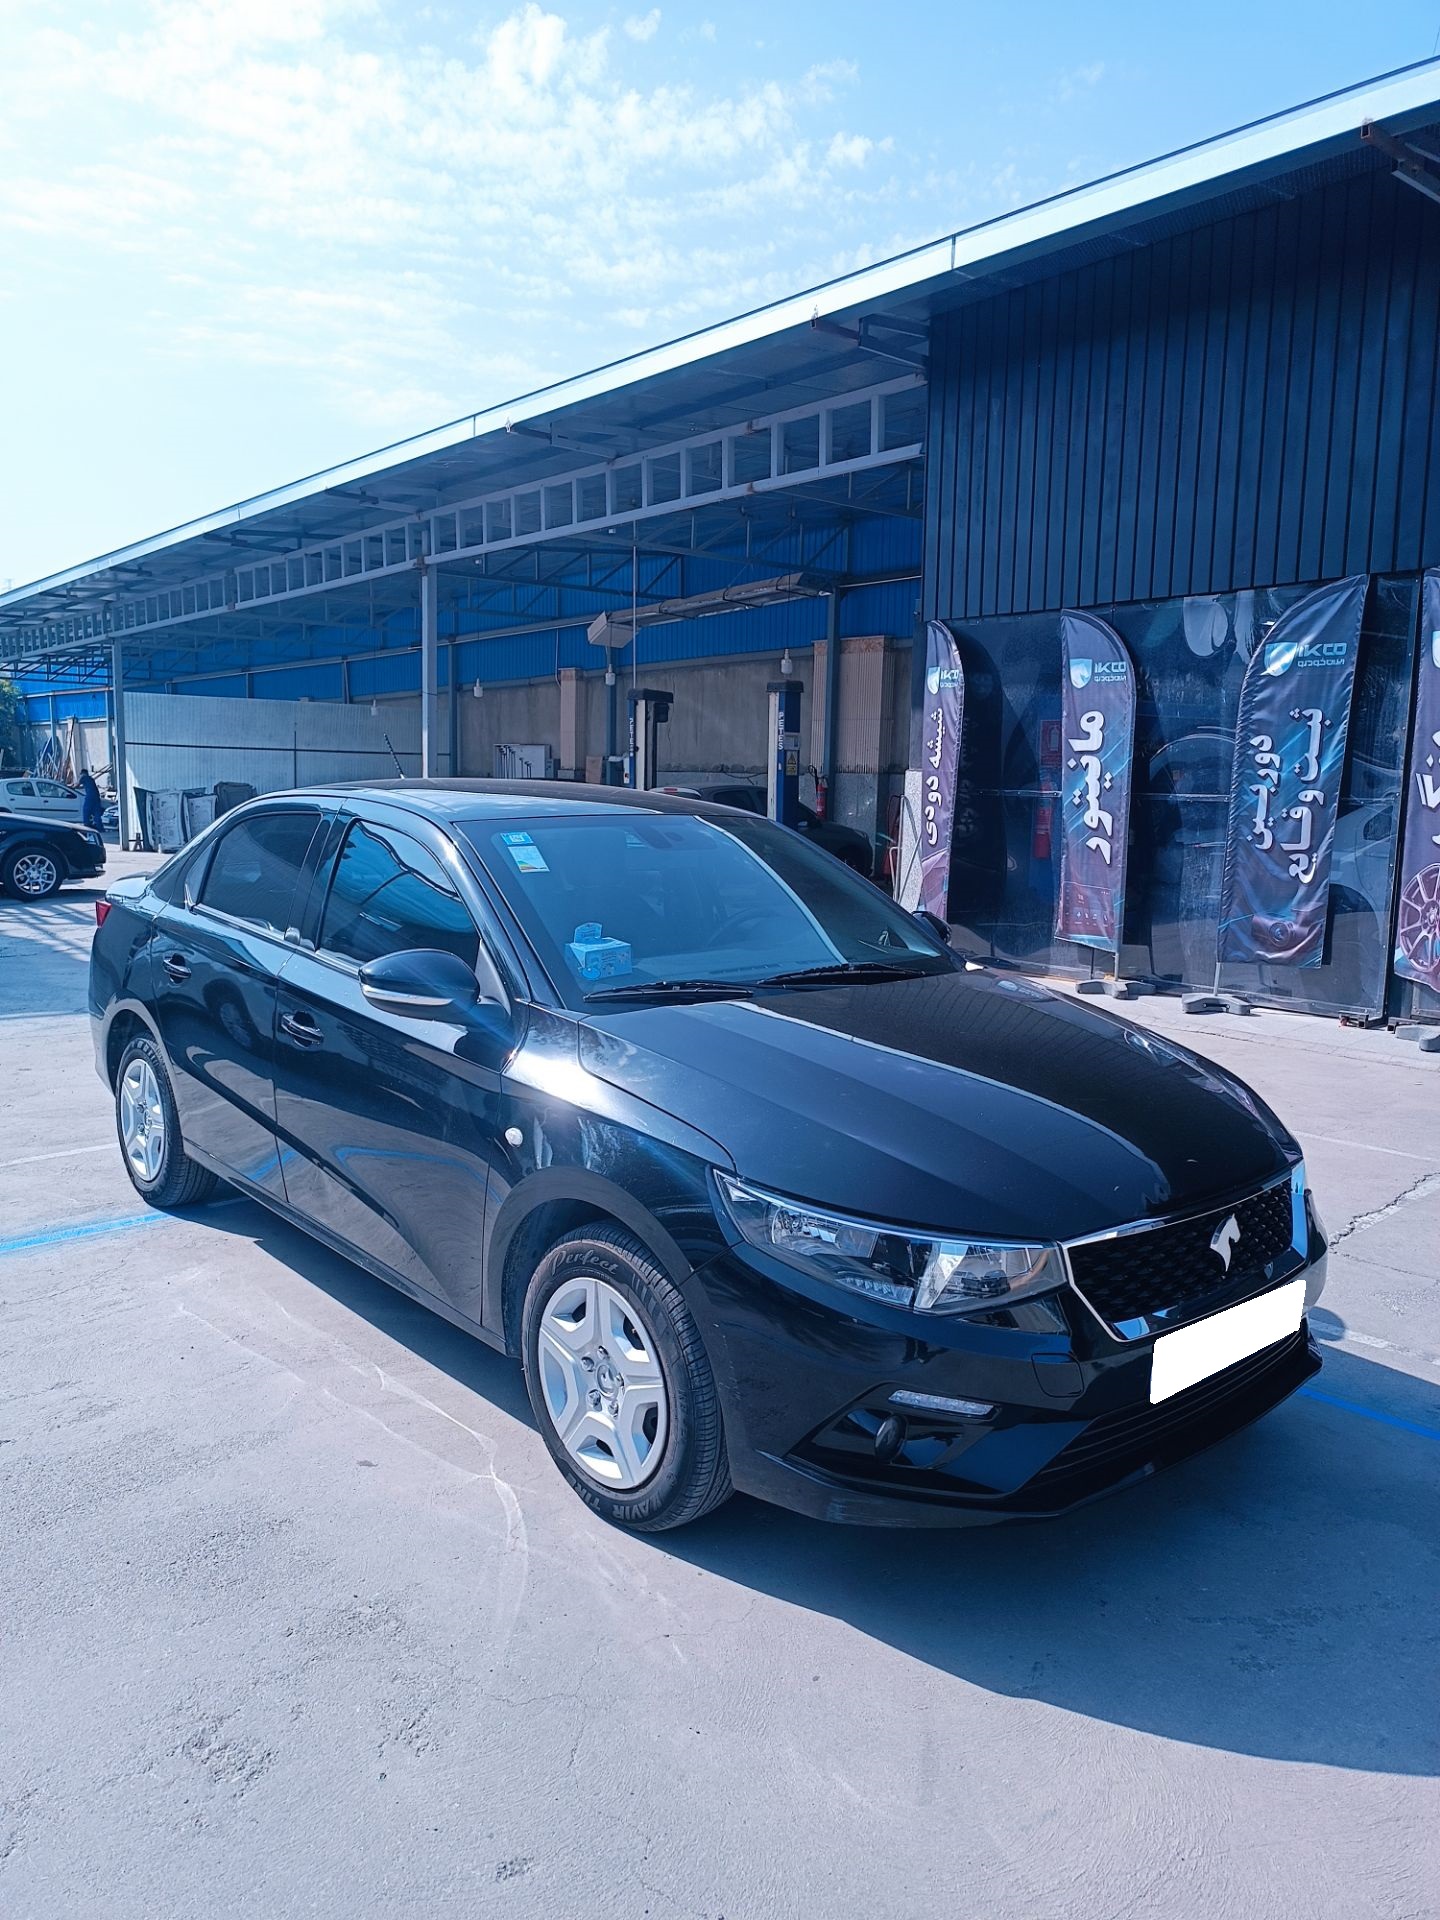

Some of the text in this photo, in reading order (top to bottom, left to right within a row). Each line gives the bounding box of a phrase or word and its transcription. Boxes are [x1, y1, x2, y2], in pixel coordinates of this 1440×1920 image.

[1094, 661, 1127, 673] IKCO
[1298, 642, 1347, 657] IKCO
[924, 708, 946, 845] شیشه دودی
[1289, 708, 1333, 782] ثبت
[1067, 710, 1113, 865] مانیتور
[1246, 735, 1281, 850] دوربین
[551, 1249, 619, 1277] Perfect
